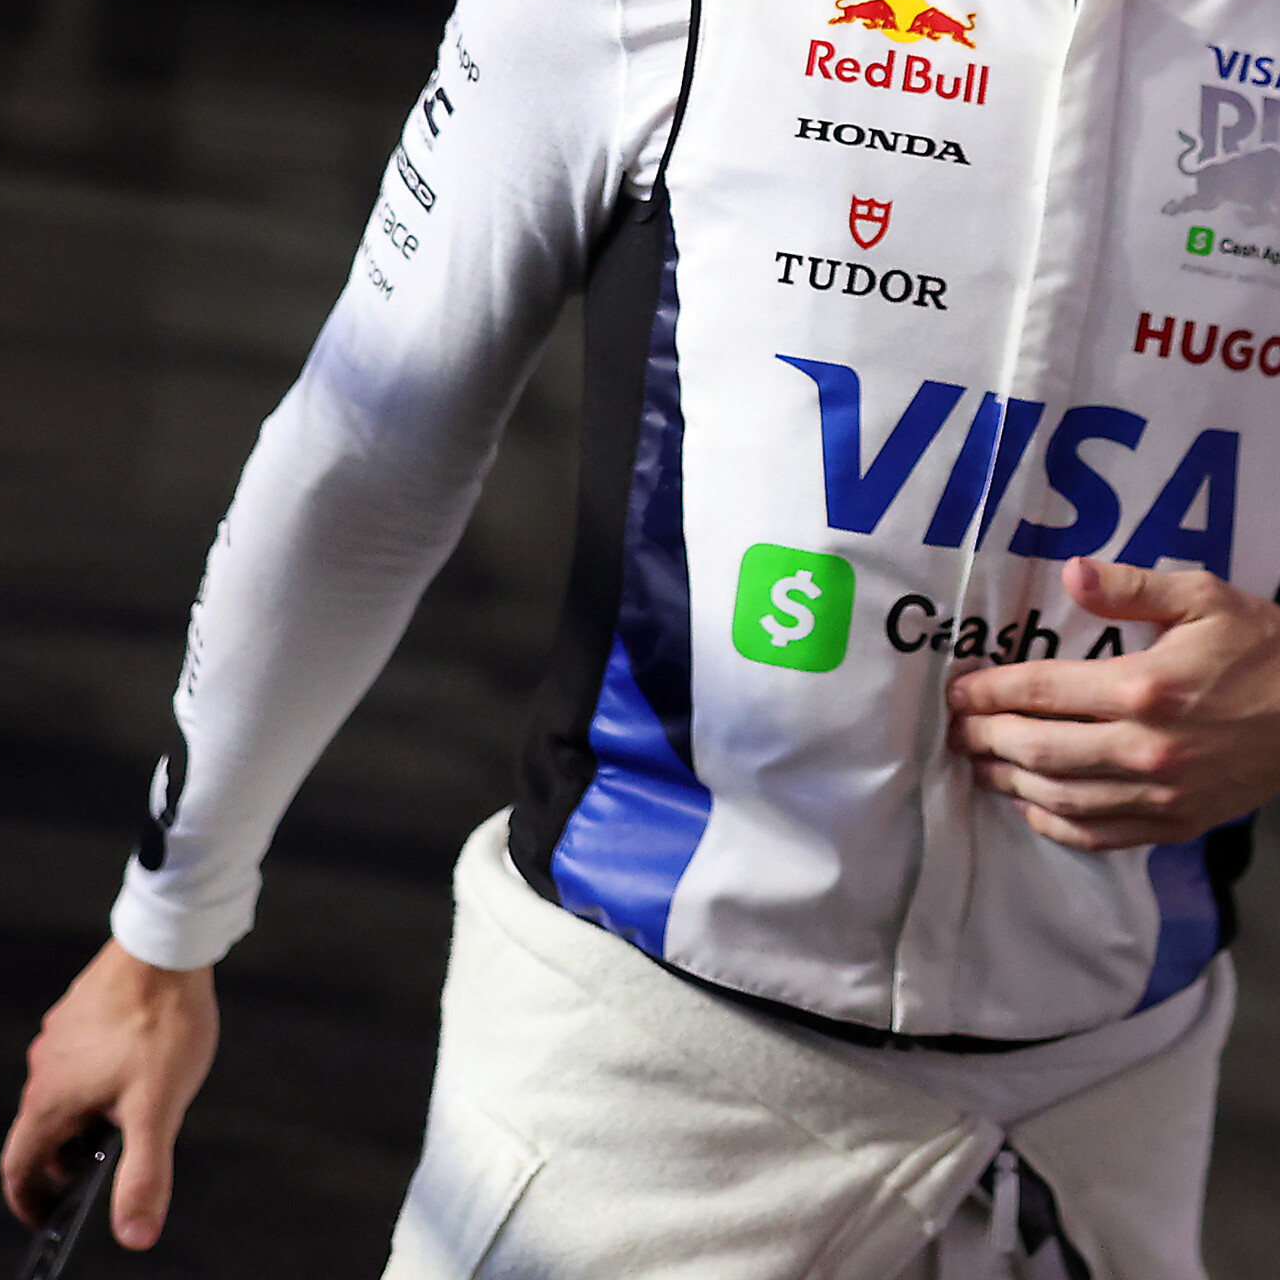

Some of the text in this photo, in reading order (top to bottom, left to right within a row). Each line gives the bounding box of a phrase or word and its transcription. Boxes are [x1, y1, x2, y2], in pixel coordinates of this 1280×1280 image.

[805, 38, 990, 106] Red Bull
[794, 117, 972, 166] HONDA
[775, 251, 949, 311] TUDOR
[774, 353, 1239, 582] VISA
